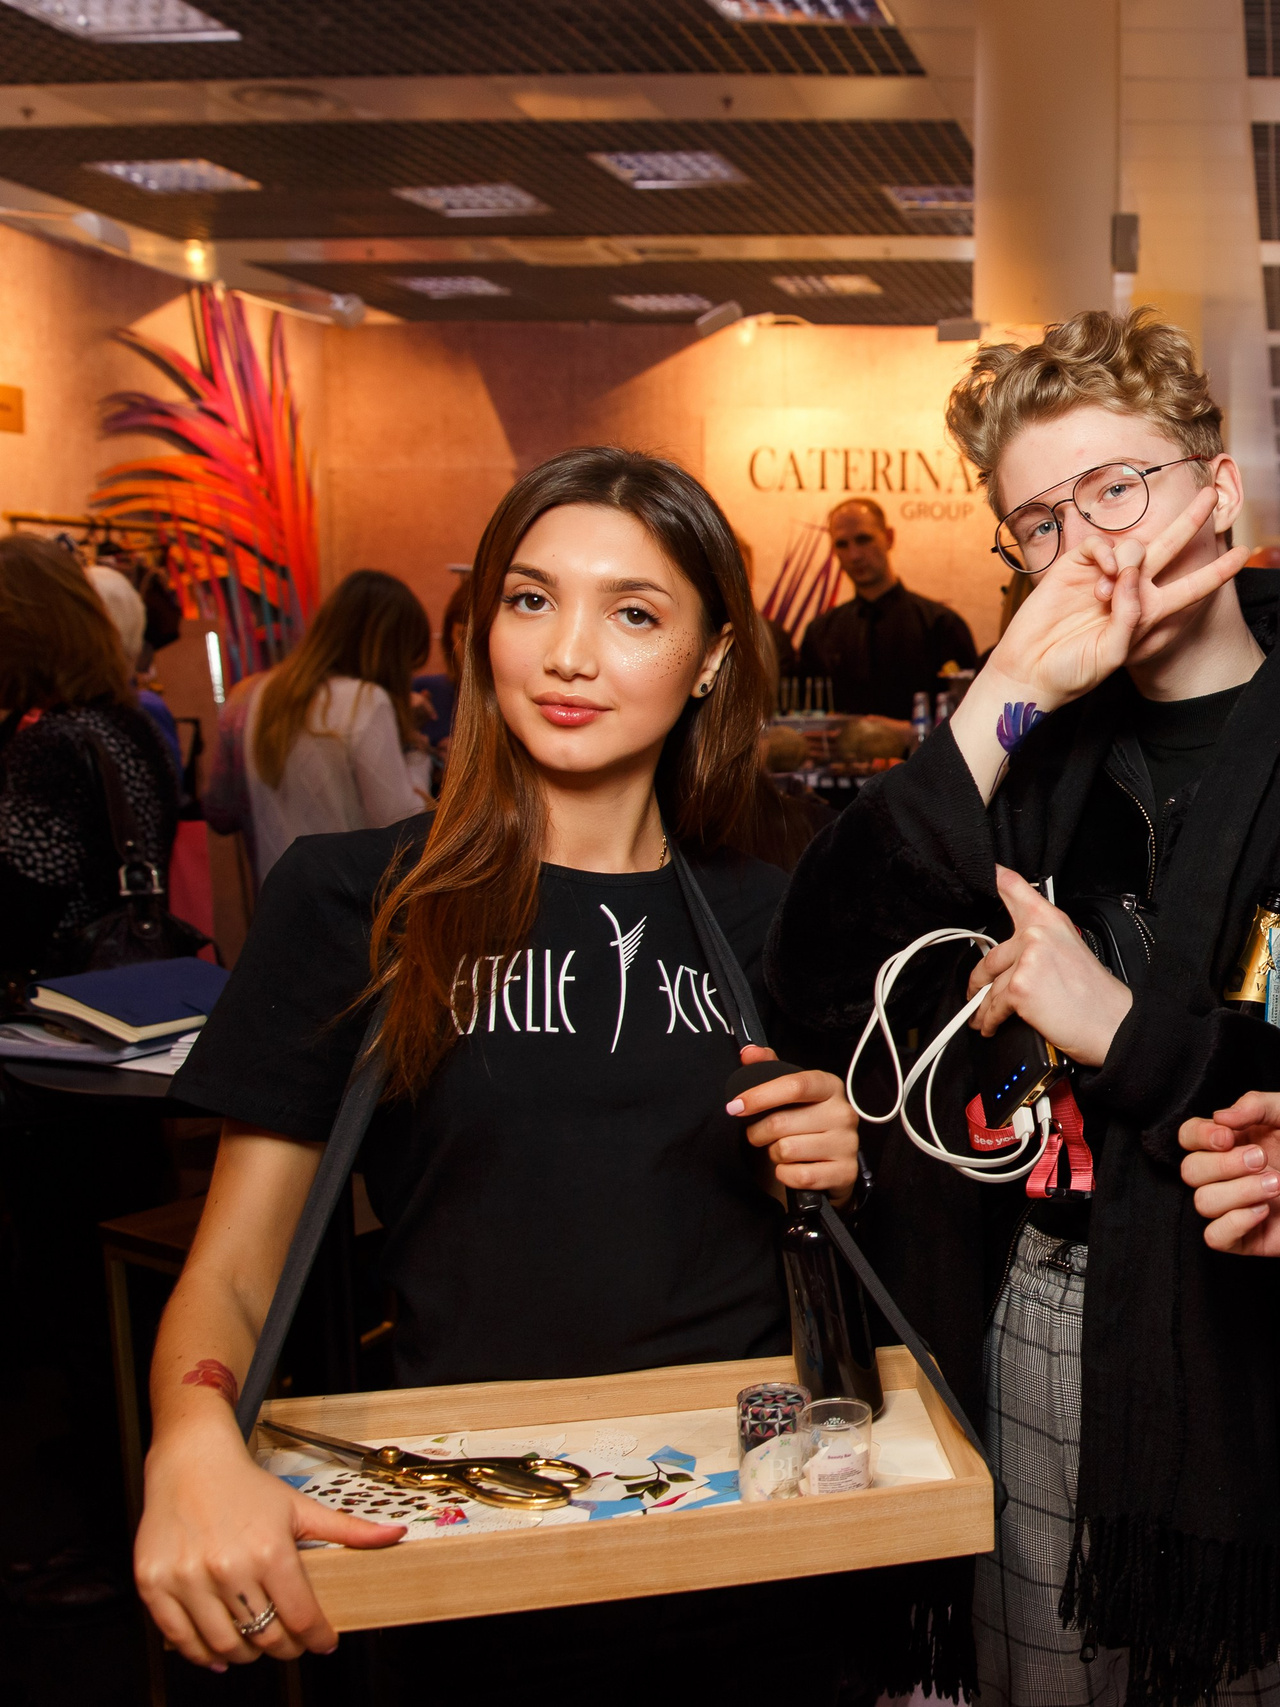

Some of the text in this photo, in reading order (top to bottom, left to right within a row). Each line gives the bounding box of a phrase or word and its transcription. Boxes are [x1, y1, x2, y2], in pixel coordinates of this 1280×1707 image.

[749, 446, 975, 494] CATERINA
[901, 501, 974, 521] GROUP
[449, 948, 577, 1036] ESTELLE
[974, 1134, 994, 1145] See
